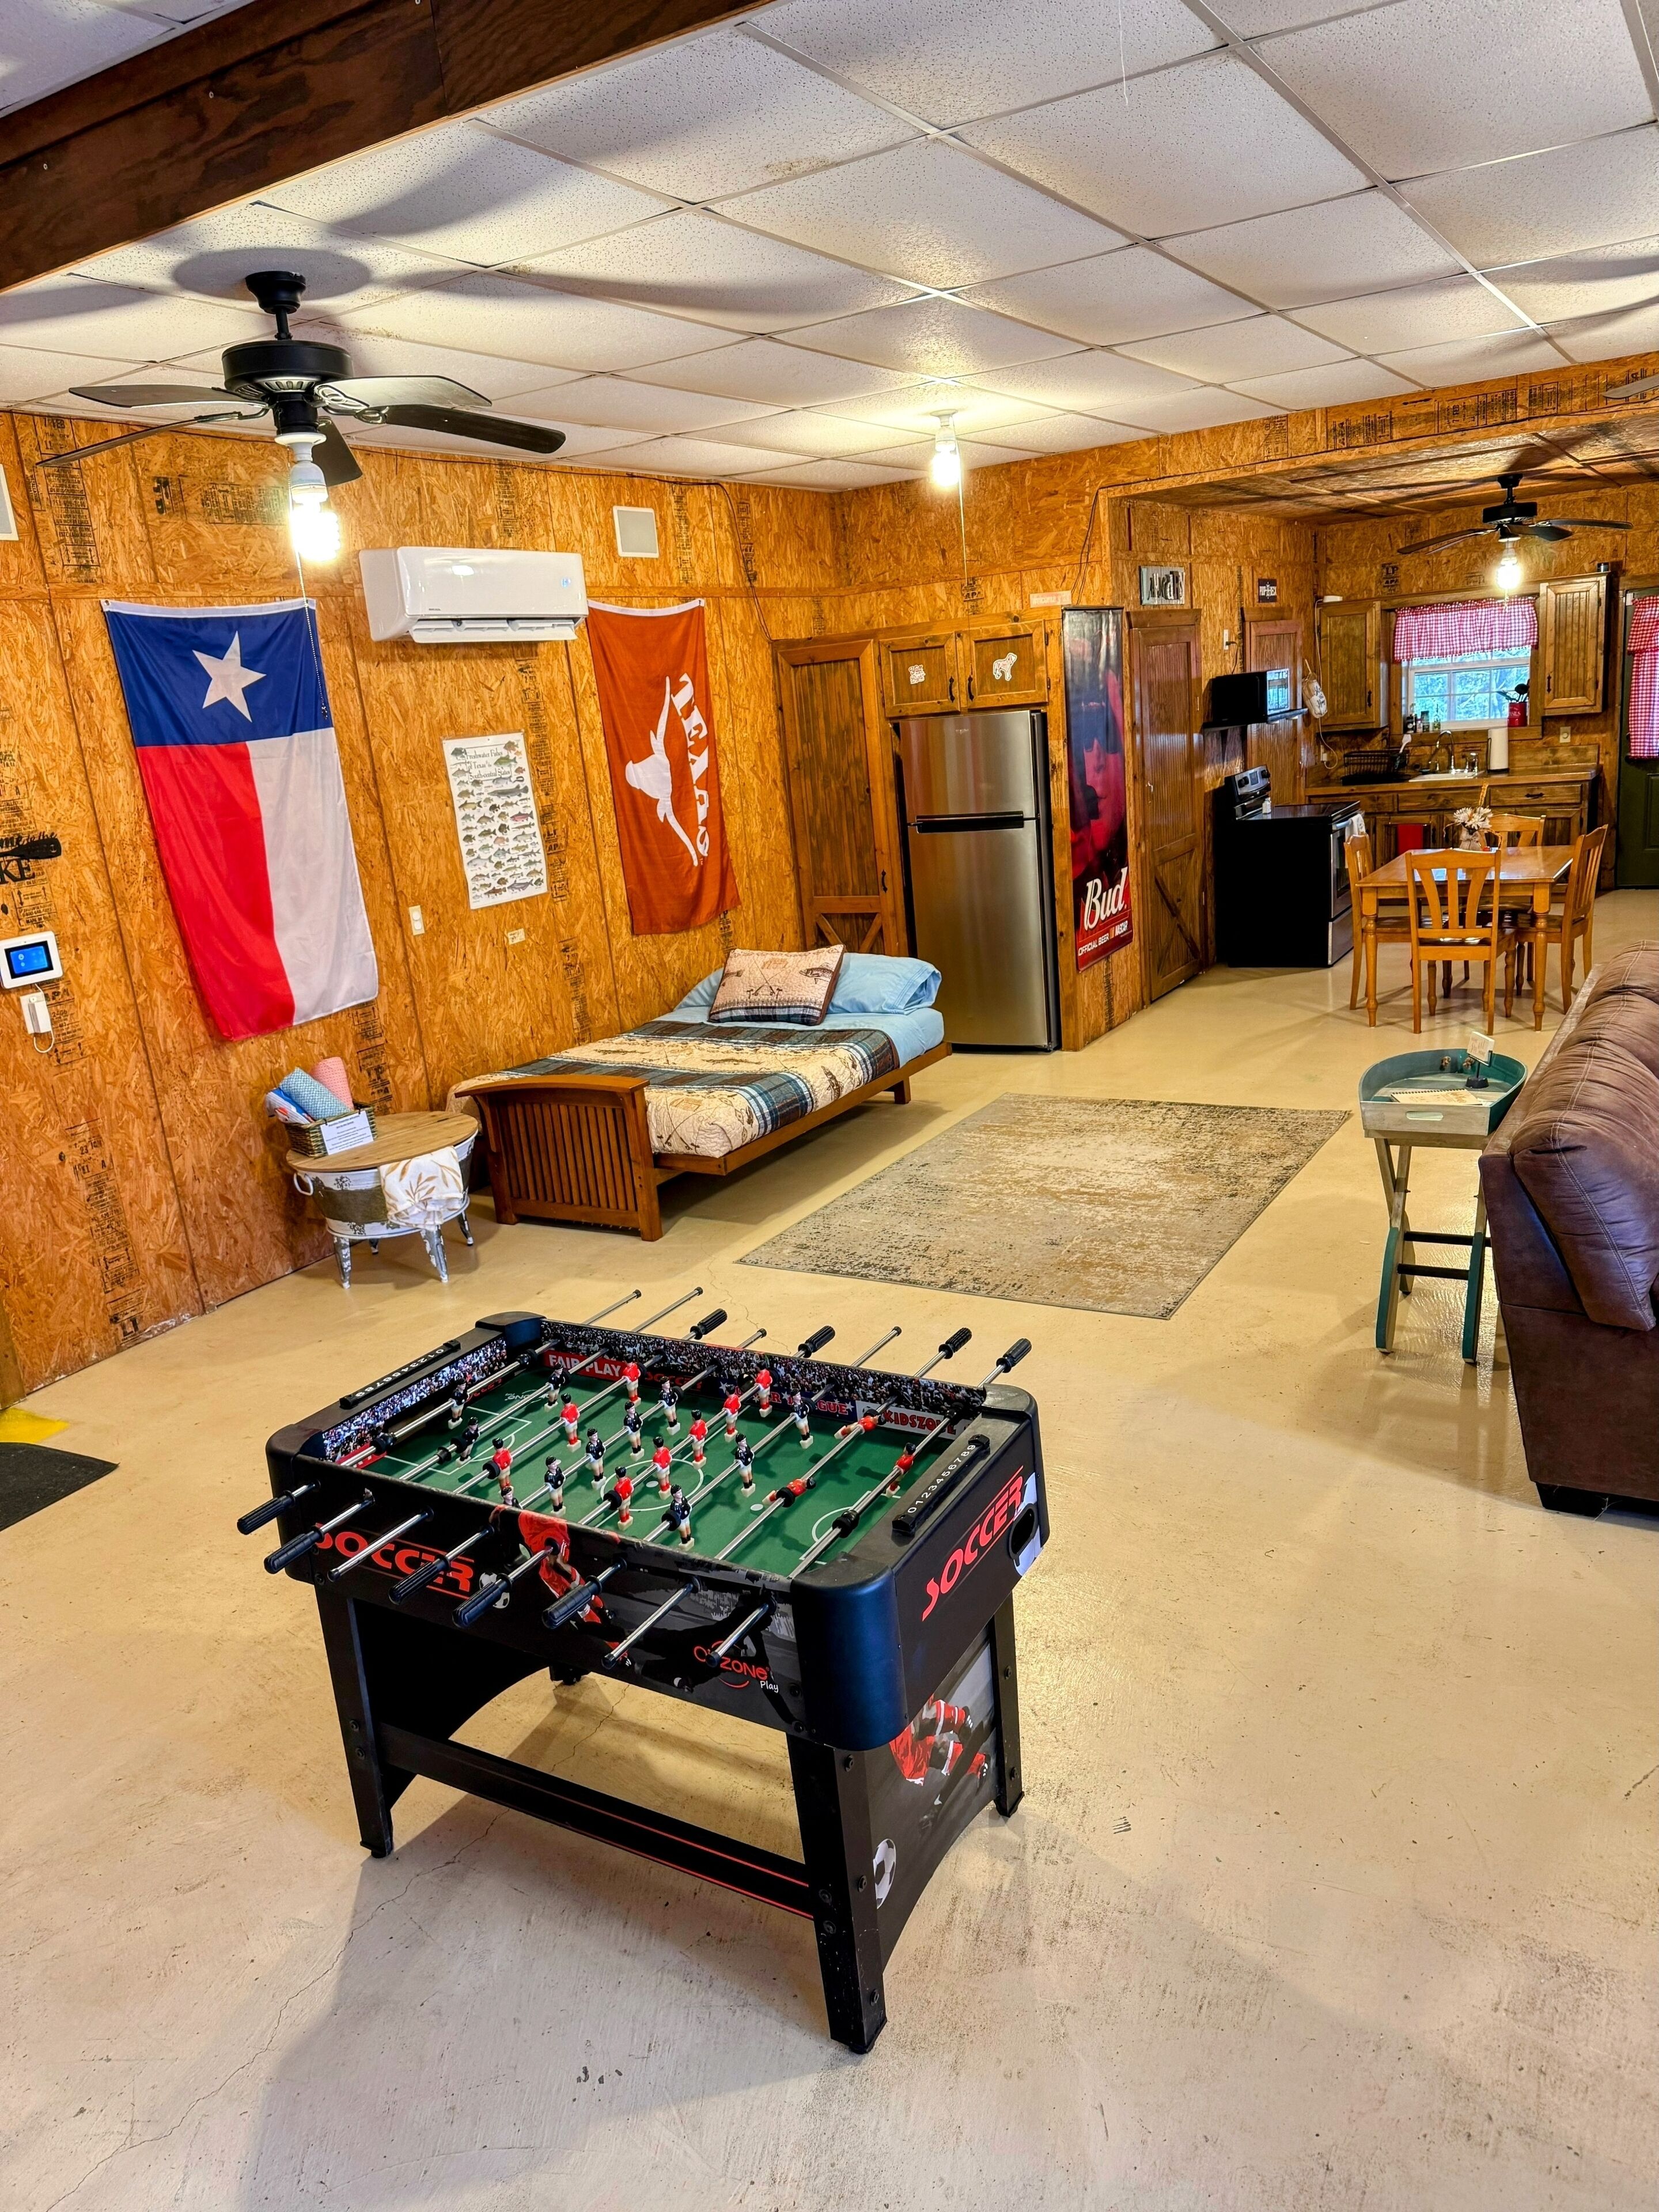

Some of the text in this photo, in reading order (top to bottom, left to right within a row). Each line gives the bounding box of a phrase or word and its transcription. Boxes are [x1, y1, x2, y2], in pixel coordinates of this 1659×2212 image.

[1078, 921, 1128, 956] OFFICIAL BEER NASCAR
[586, 1361, 621, 1377] PLAY
[922, 1474, 1024, 1622] SOCCER
[760, 1680, 779, 1694] Play
